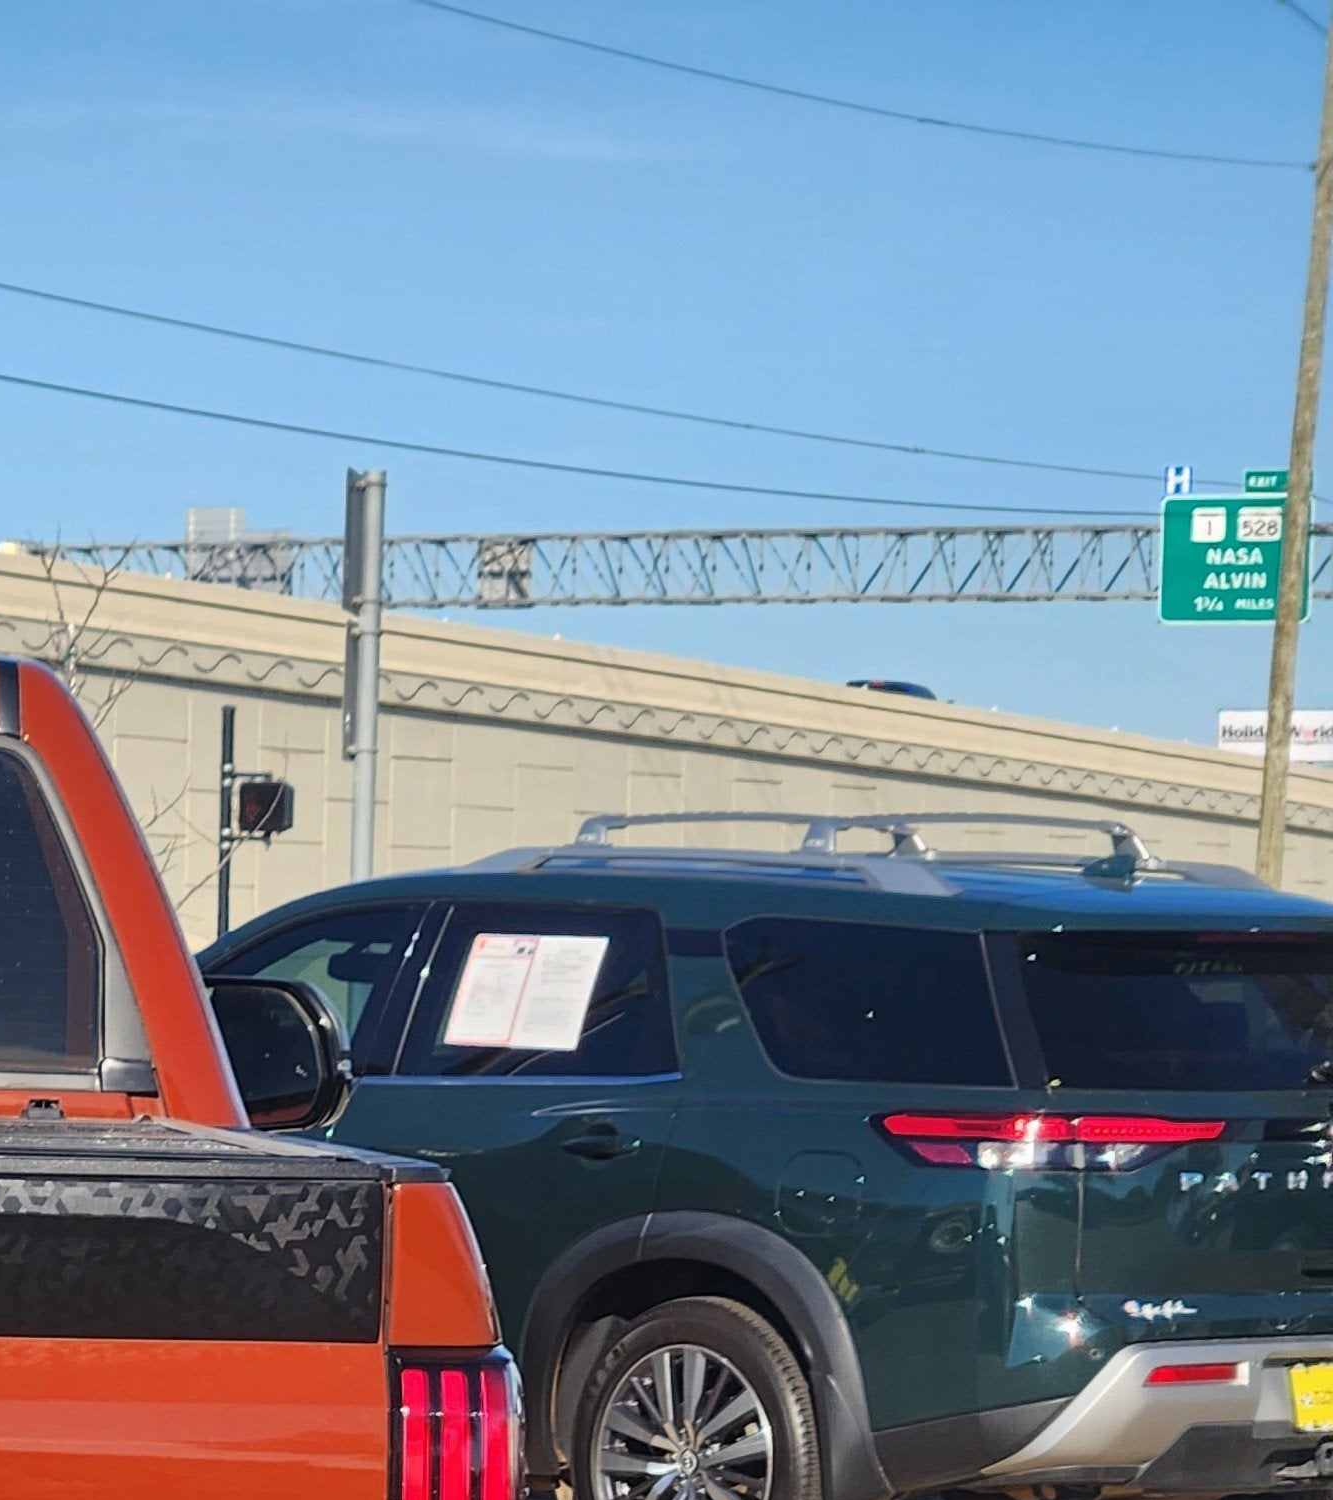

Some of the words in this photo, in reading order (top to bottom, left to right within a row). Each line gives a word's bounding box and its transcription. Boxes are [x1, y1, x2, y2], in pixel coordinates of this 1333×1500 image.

[1167, 467, 1191, 494] H
[1242, 519, 1279, 538] 528
[1205, 547, 1264, 566] NASA
[1202, 571, 1267, 590] ALVIN
